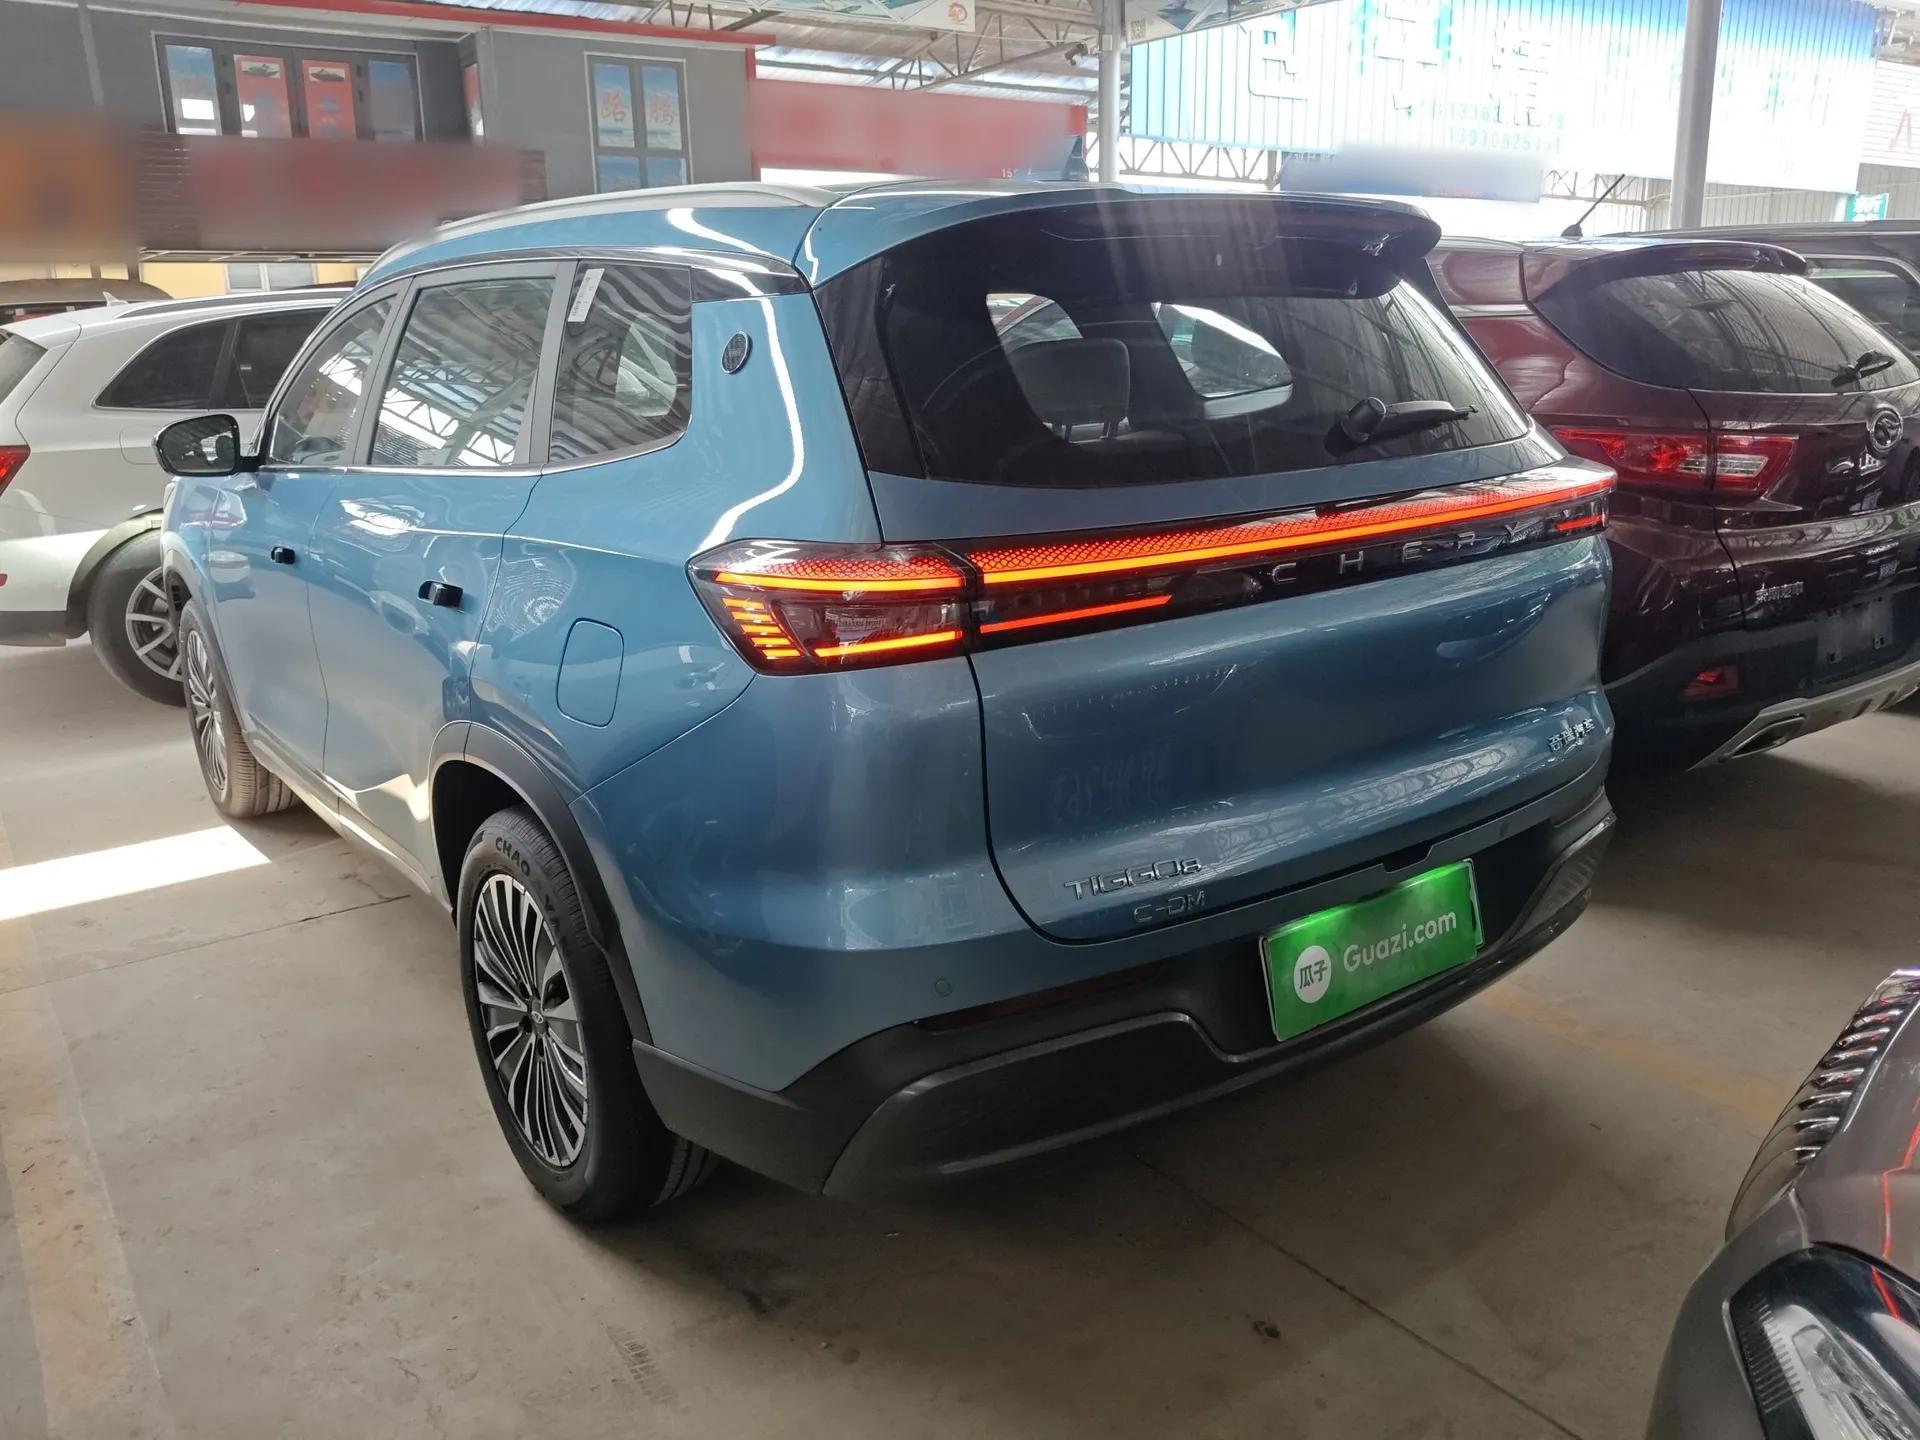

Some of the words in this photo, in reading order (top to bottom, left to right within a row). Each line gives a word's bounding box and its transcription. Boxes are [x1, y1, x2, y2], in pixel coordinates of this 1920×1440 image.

[1272, 521, 1519, 583] CHERY
[1549, 718, 1595, 751] 奇瑞汽车
[495, 837, 530, 877] CHAO
[1134, 889, 1205, 921] C-DM
